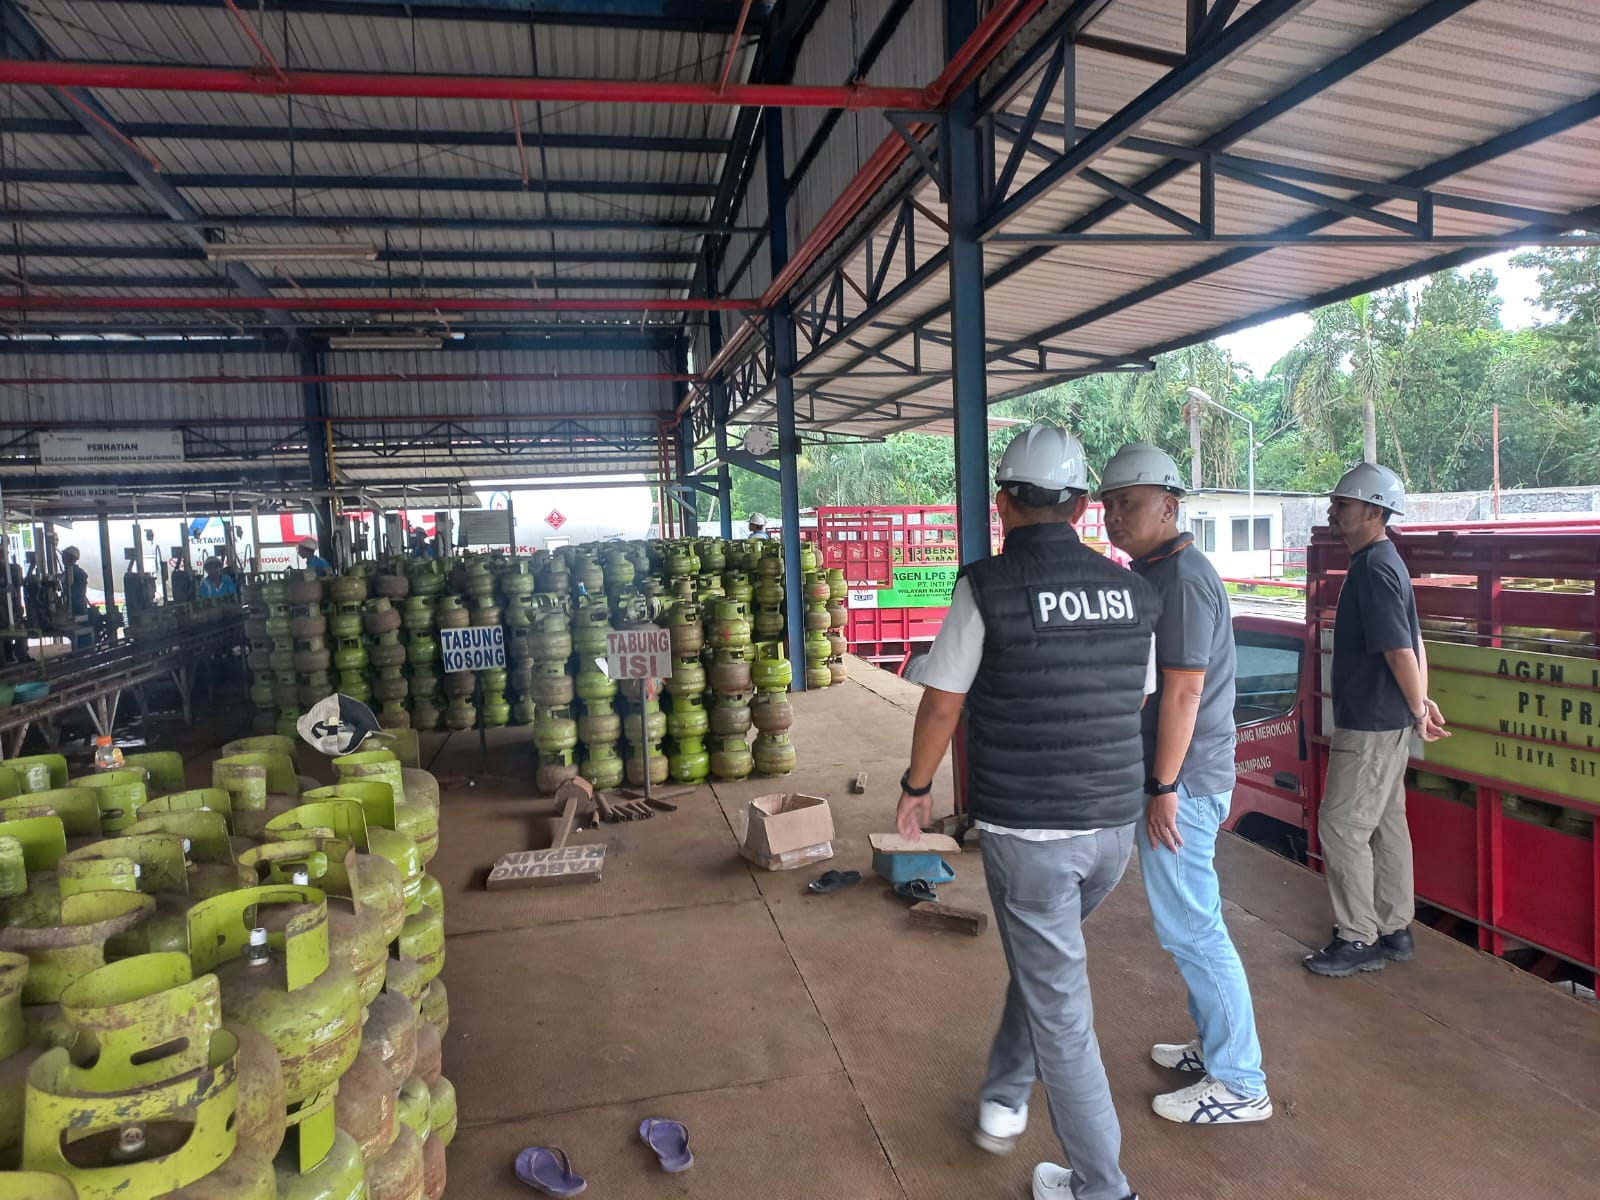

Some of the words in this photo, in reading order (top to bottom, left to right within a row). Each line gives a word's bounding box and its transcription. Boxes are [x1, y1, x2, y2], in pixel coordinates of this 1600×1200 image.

[893, 572, 922, 581] AGEN
[925, 571, 946, 580] LPG
[1038, 589, 1134, 622] POLISI
[442, 627, 503, 650] TABUNG
[607, 632, 669, 654] TABUNG
[443, 650, 505, 671] KOSONG
[619, 655, 657, 678] ISI
[1497, 658, 1564, 689] AGEN
[1518, 691, 1548, 719] PT.
[1561, 698, 1600, 729] PR
[1255, 720, 1293, 742] MEROKOK
[1499, 719, 1568, 744] WILAYAH
[1516, 745, 1555, 768] RAYA
[492, 861, 600, 877] TABUNG
